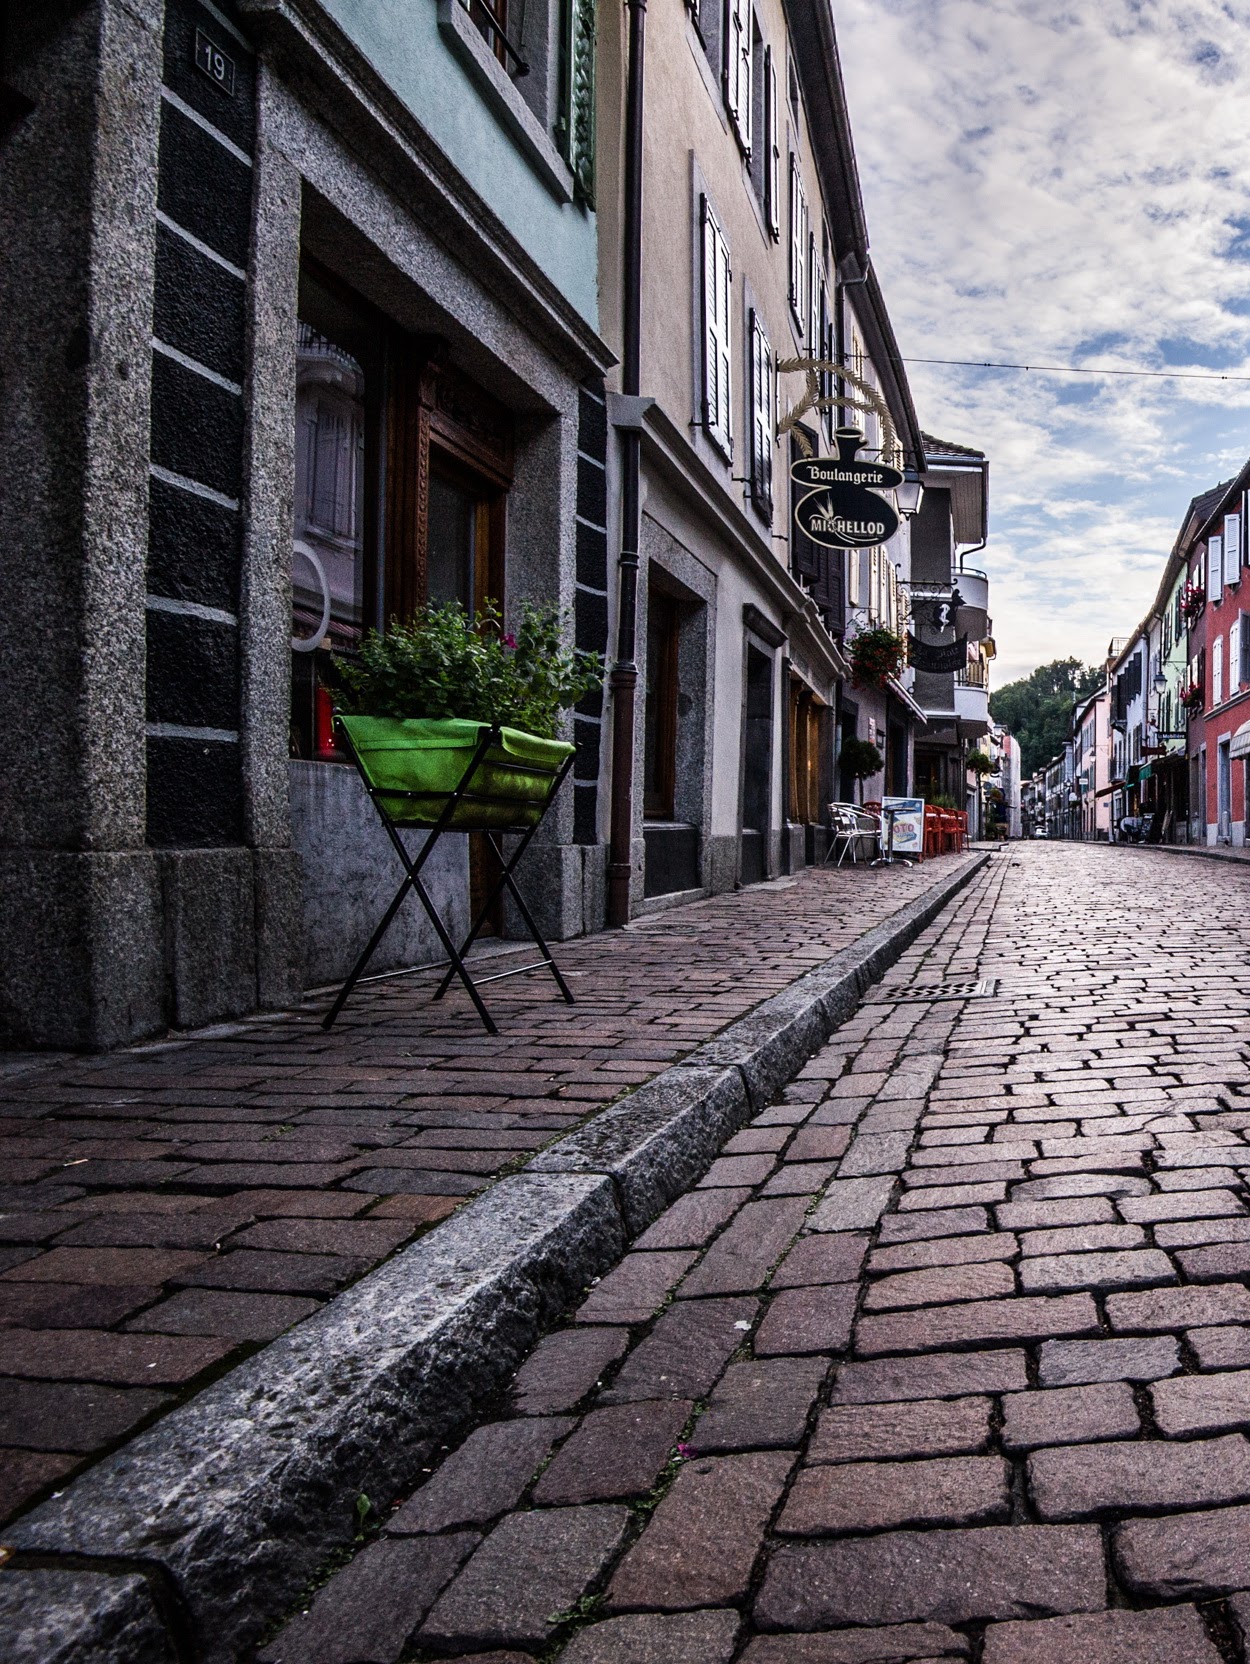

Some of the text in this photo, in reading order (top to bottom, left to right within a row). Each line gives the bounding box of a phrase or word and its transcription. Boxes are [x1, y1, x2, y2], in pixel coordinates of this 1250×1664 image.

[205, 45, 225, 81] 19
[806, 466, 884, 485] Boulangerie
[810, 519, 885, 535] MICHELLOD
[892, 823, 914, 834] OTO
